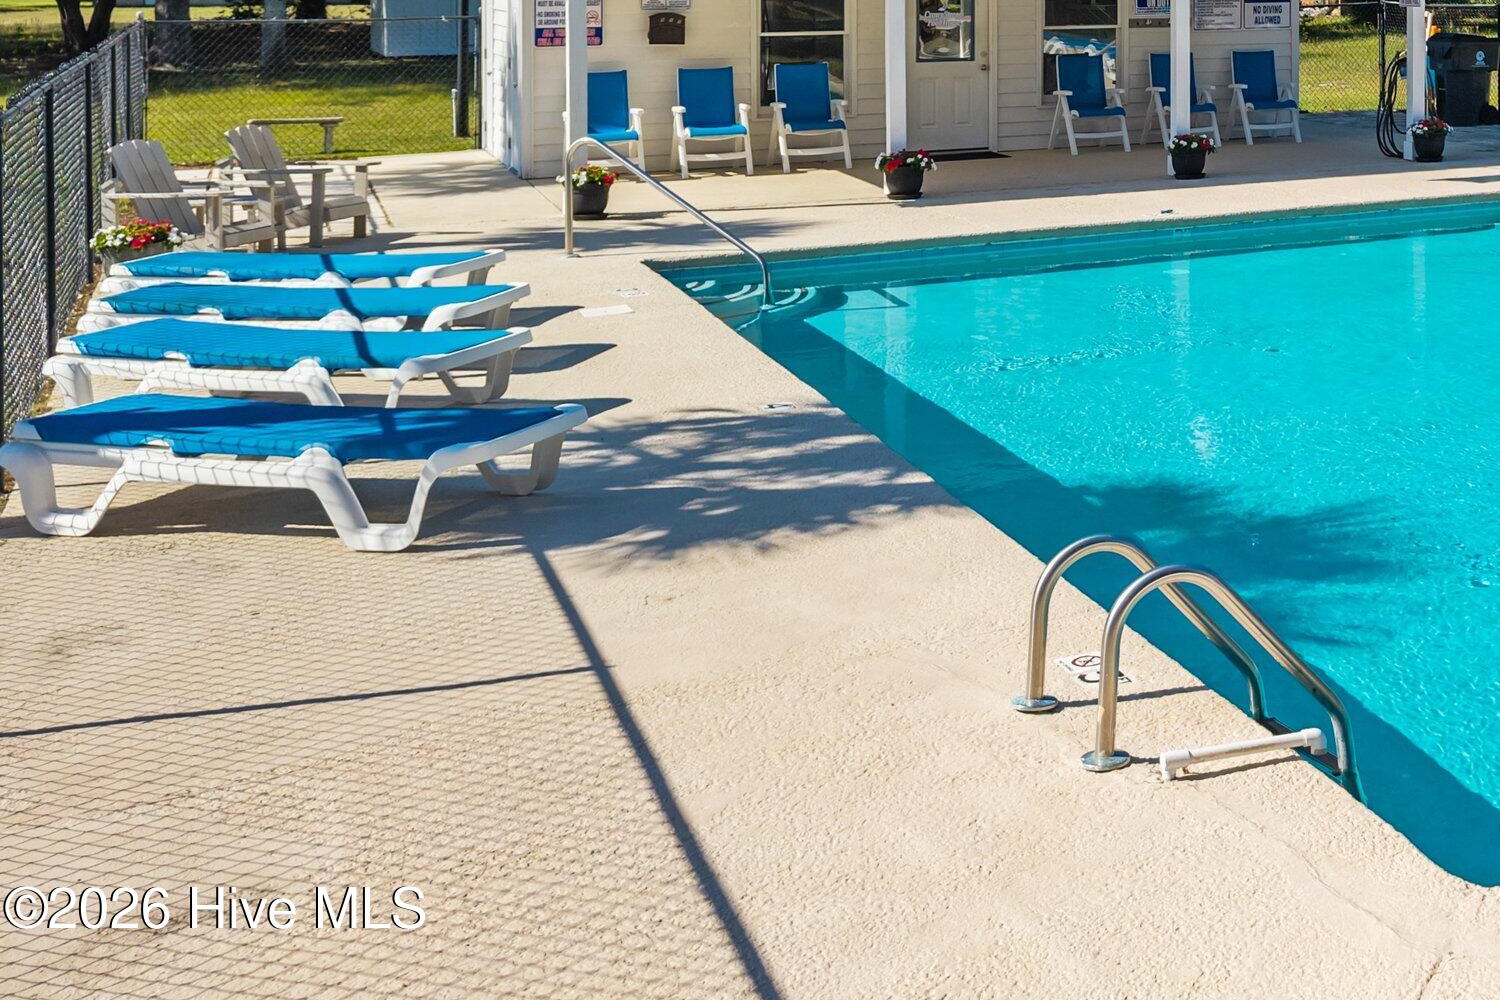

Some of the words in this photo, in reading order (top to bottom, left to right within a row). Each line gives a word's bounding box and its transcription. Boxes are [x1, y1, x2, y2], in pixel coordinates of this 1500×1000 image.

[1253, 6, 1261, 14] NO
[1263, 6, 1282, 14] DIVING
[1254, 16, 1281, 24] ALLOWED
